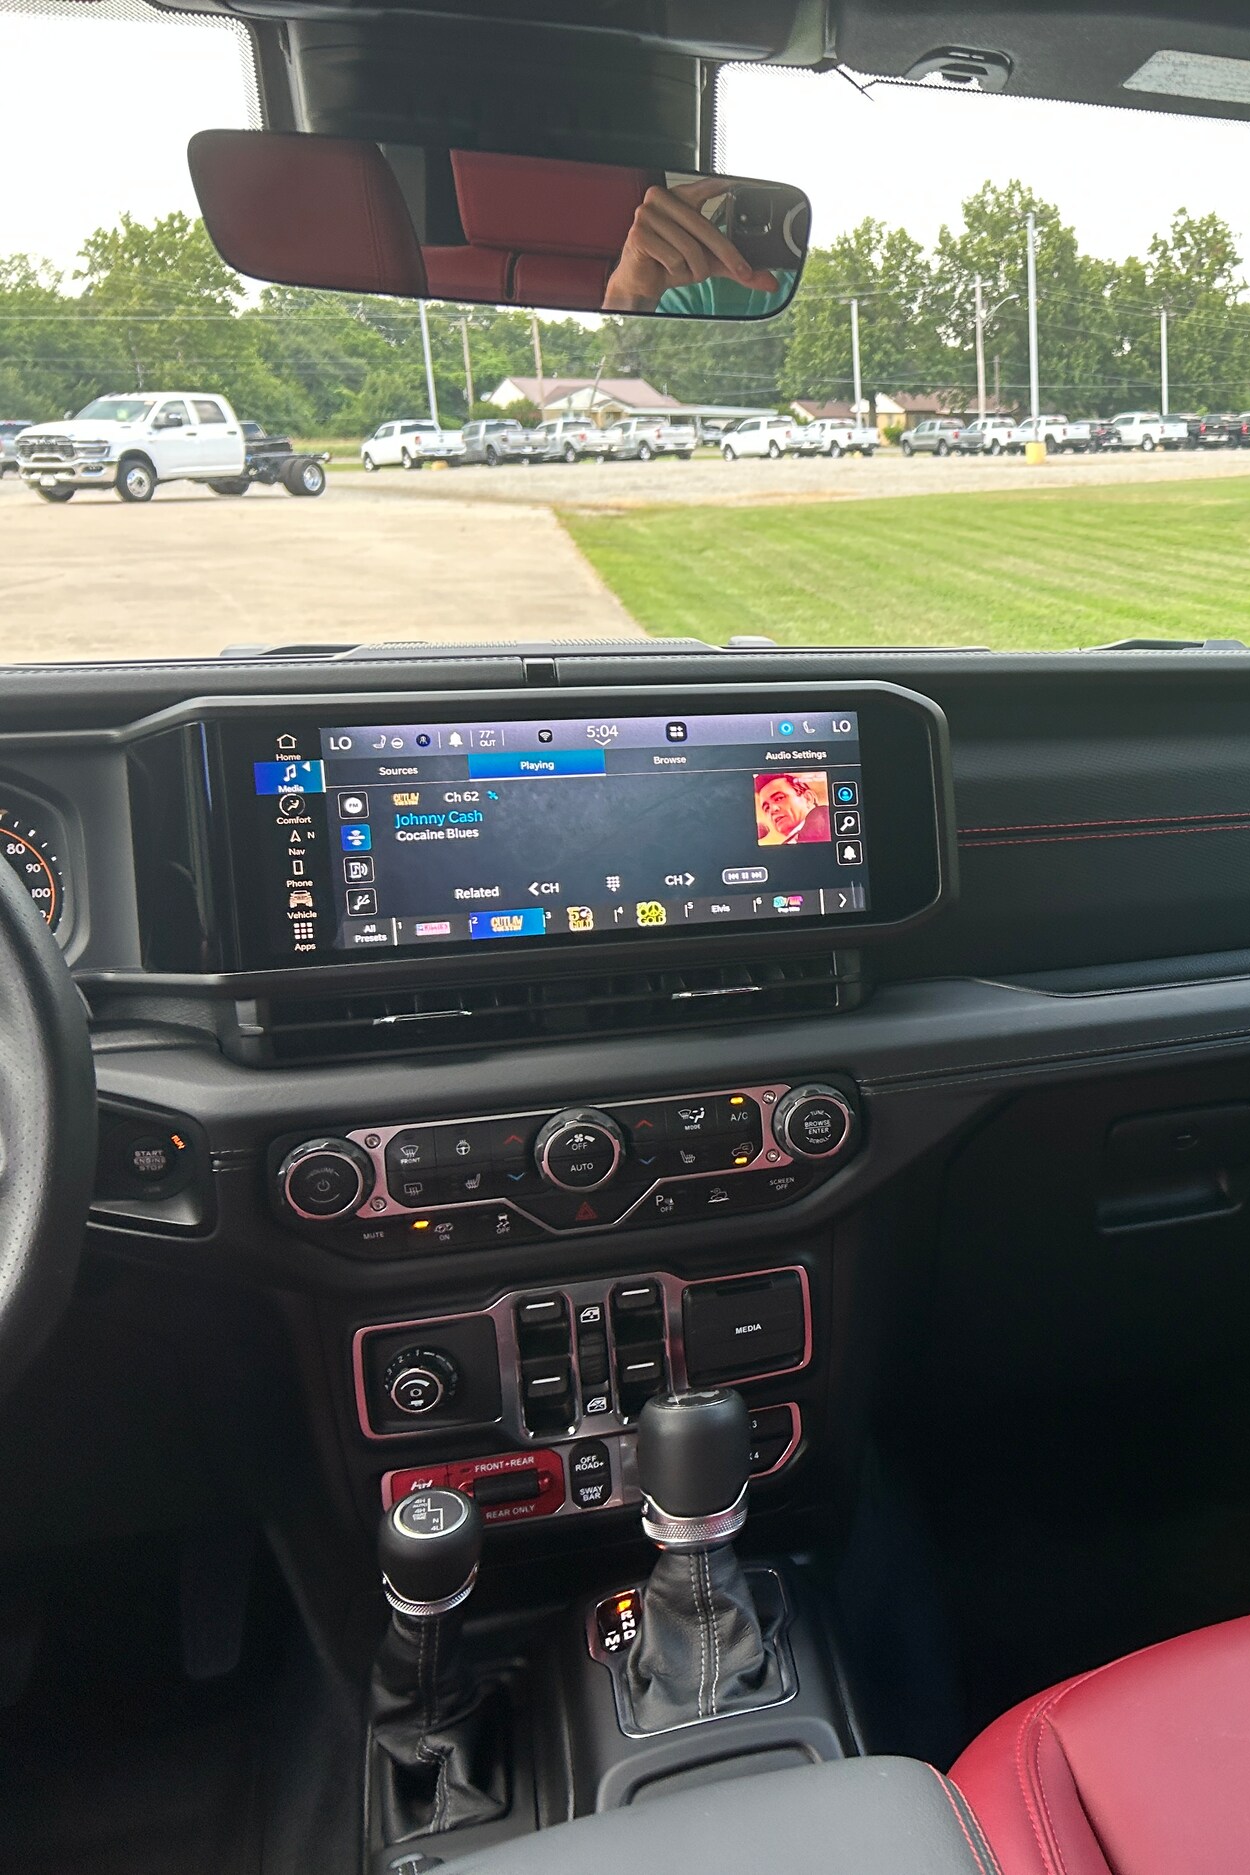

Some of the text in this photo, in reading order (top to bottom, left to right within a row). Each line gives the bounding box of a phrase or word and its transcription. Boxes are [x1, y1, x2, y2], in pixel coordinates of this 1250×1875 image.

[586, 725, 619, 738] 5:04
[832, 720, 851, 733] LO
[329, 736, 352, 750] LO
[480, 739, 496, 747] OUT
[275, 753, 302, 762] Home
[653, 756, 687, 765] Browse
[765, 750, 827, 761] Audio Settings
[520, 761, 555, 771] Playing
[379, 767, 418, 776] Sources
[277, 785, 304, 793] Media
[444, 791, 480, 802] Ch 62
[276, 816, 312, 826] Comfort
[395, 809, 483, 829] Johnny Cash
[307, 831, 315, 839] N
[396, 827, 479, 841] Cocaine Blues
[6, 843, 26, 855] 80
[288, 848, 306, 856] Nav
[25, 863, 42, 873] 90
[286, 879, 313, 889] Phone
[664, 875, 683, 886] CH
[31, 887, 52, 899] 100
[454, 886, 500, 900] Related
[540, 882, 560, 894] CH
[710, 904, 731, 914] Elvis
[287, 911, 317, 920] Vehicle
[640, 915, 665, 924] GOLD
[363, 925, 376, 934] All
[354, 933, 388, 943] Presets
[294, 942, 316, 952] Apps
[730, 1112, 749, 1122] A/C
[804, 1119, 831, 1128] BROWSE
[571, 1142, 588, 1151] OFF
[133, 1156, 167, 1165] ENGINE
[570, 1163, 594, 1173] AUTO
[769, 1177, 795, 1186] SCREEN
[363, 1232, 384, 1240] MUTE
[496, 1227, 511, 1235] OFF
[735, 1323, 762, 1335] MEDIA
[580, 1456, 597, 1464] OFF
[580, 1485, 604, 1495] SWAY
[583, 1492, 601, 1501] BAR
[486, 1504, 535, 1519] REAR ONLY
[621, 1610, 633, 1621] R
[622, 1618, 636, 1630] N
[623, 1629, 637, 1640] D
[605, 1634, 621, 1647] M
